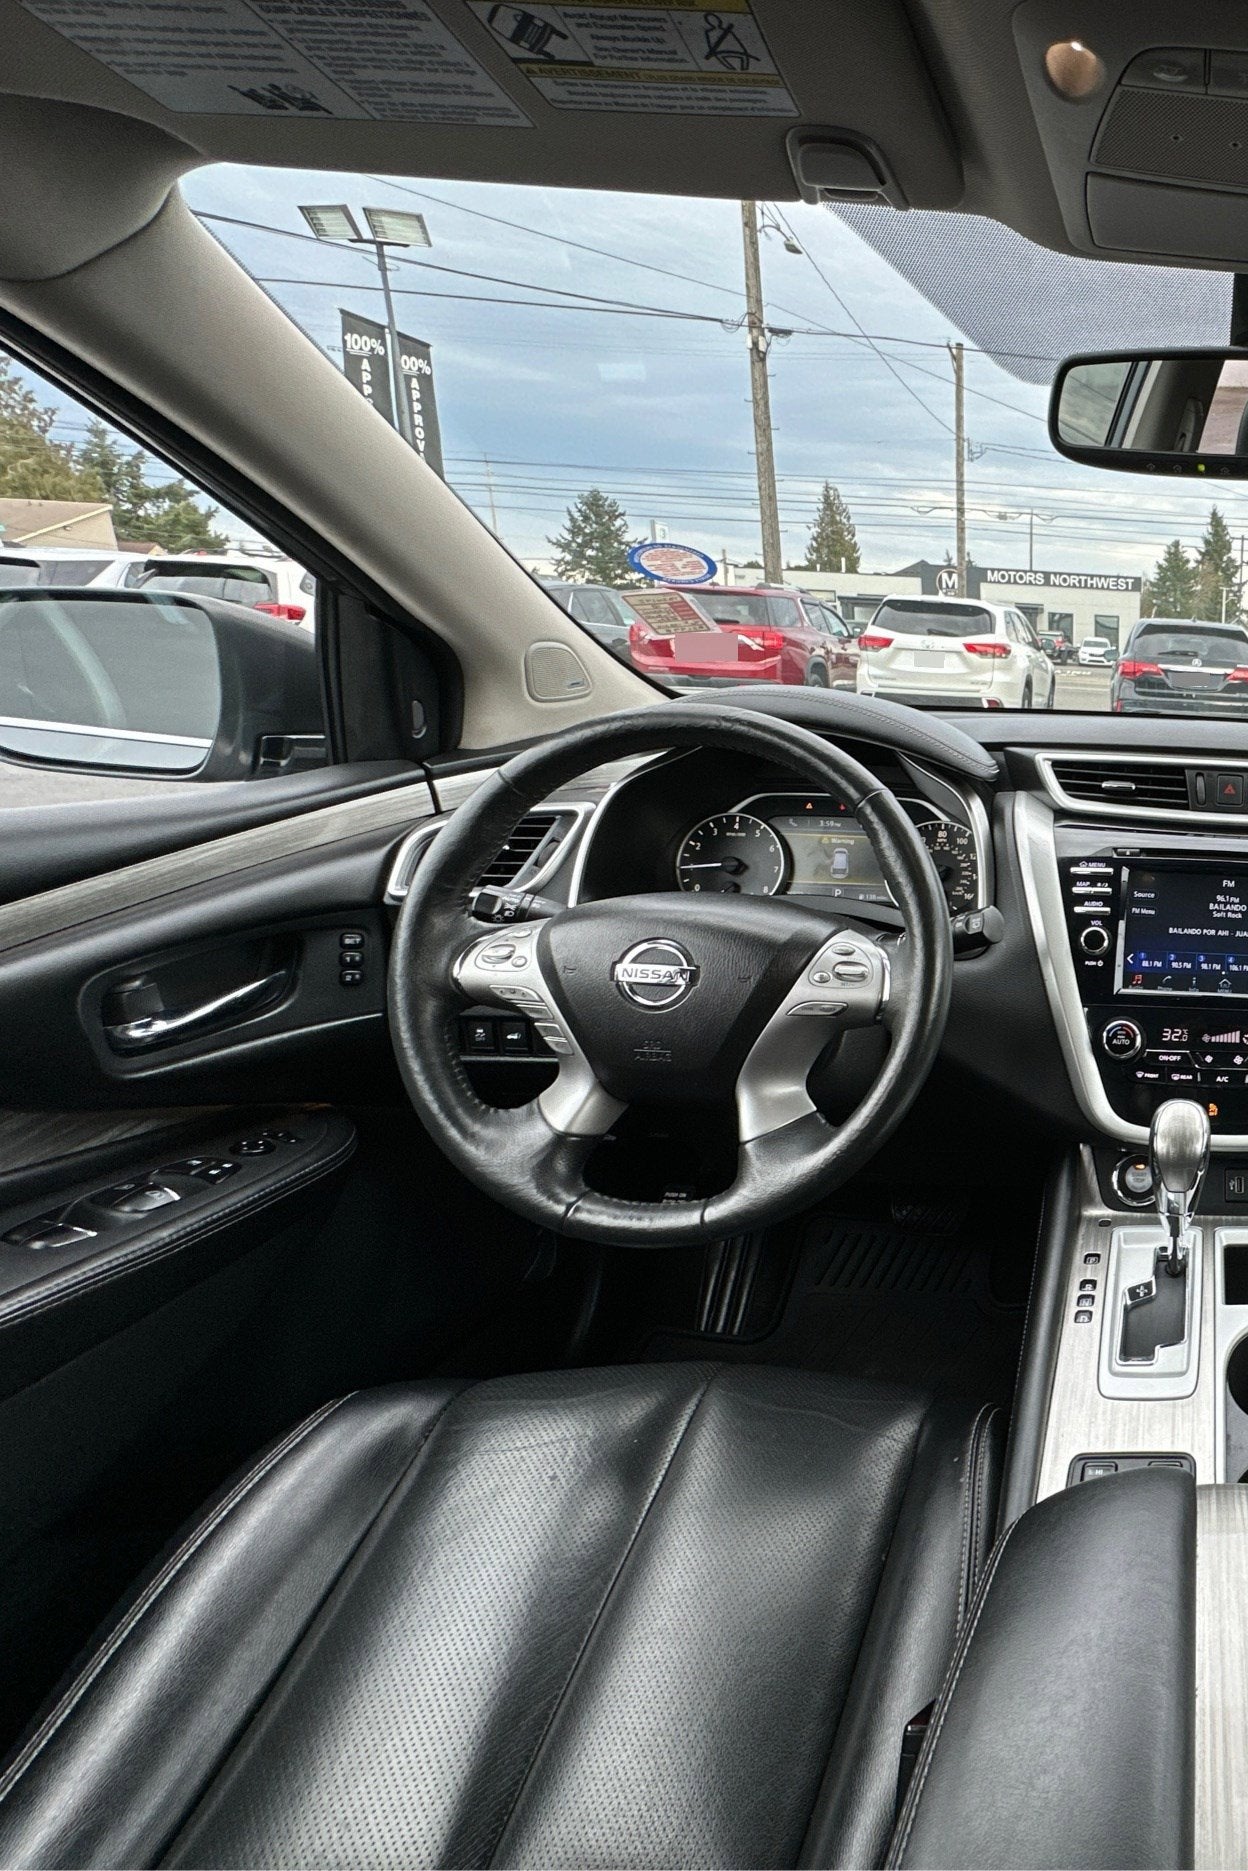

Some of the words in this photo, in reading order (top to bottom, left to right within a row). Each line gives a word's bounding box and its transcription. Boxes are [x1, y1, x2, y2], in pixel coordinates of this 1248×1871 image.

[344, 332, 385, 356] 100%
[401, 354, 432, 376] 00%
[941, 573, 958, 589] M
[986, 569, 1045, 586] MOTORS
[1049, 573, 1134, 591] NORTHWEST
[712, 828, 718, 836] 3
[694, 884, 700, 892] 0
[1223, 880, 1235, 888] FM
[835, 889, 842, 897] P
[1209, 903, 1247, 912] BAILANDO
[1227, 911, 1242, 919] Rock
[1168, 927, 1202, 936] BAILANDO
[1203, 928, 1215, 936] POR
[621, 968, 689, 981] NISSAN
